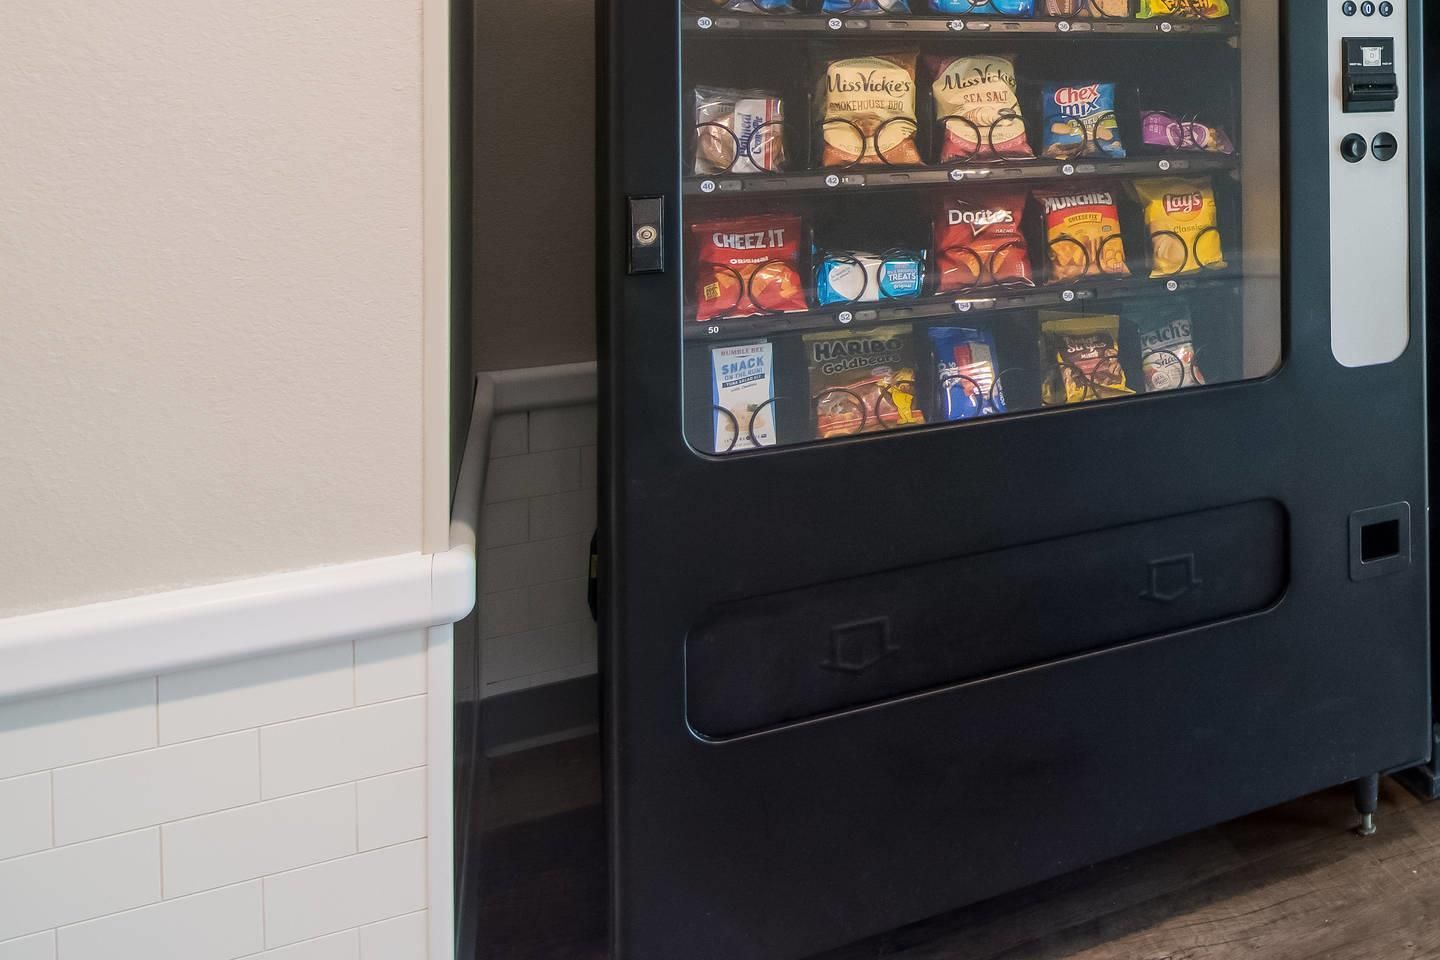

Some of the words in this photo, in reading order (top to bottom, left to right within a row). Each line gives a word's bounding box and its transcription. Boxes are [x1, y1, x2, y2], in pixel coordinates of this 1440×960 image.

[1365, 4, 1372, 14] 0
[953, 21, 963, 29] 34
[827, 73, 862, 93] Miss
[857, 70, 912, 98] Vickie's
[942, 74, 979, 91] Miss
[963, 93, 983, 104] SEA
[986, 90, 1009, 103] SALT
[1054, 84, 1101, 106] Chex
[829, 99, 884, 112] SMOKEHOUSE
[887, 100, 904, 113] BBQ
[1060, 97, 1100, 118] mix
[702, 182, 714, 191] 40
[828, 177, 837, 185] 42
[1045, 192, 1113, 214] MUNCHIES
[1165, 193, 1201, 213] Lay's
[948, 209, 1014, 225] Doritos
[1173, 225, 1203, 235] Classic
[887, 271, 917, 281] TREATS
[840, 313, 850, 321] 52
[708, 326, 719, 335] 50
[721, 348, 749, 357] BUMBLE
[750, 346, 764, 354] BEE
[814, 337, 905, 362] HARIBO
[721, 355, 765, 375] SNACK
[823, 353, 900, 376] Goldbears
[724, 373, 736, 381] ON
[736, 370, 748, 379] THE
